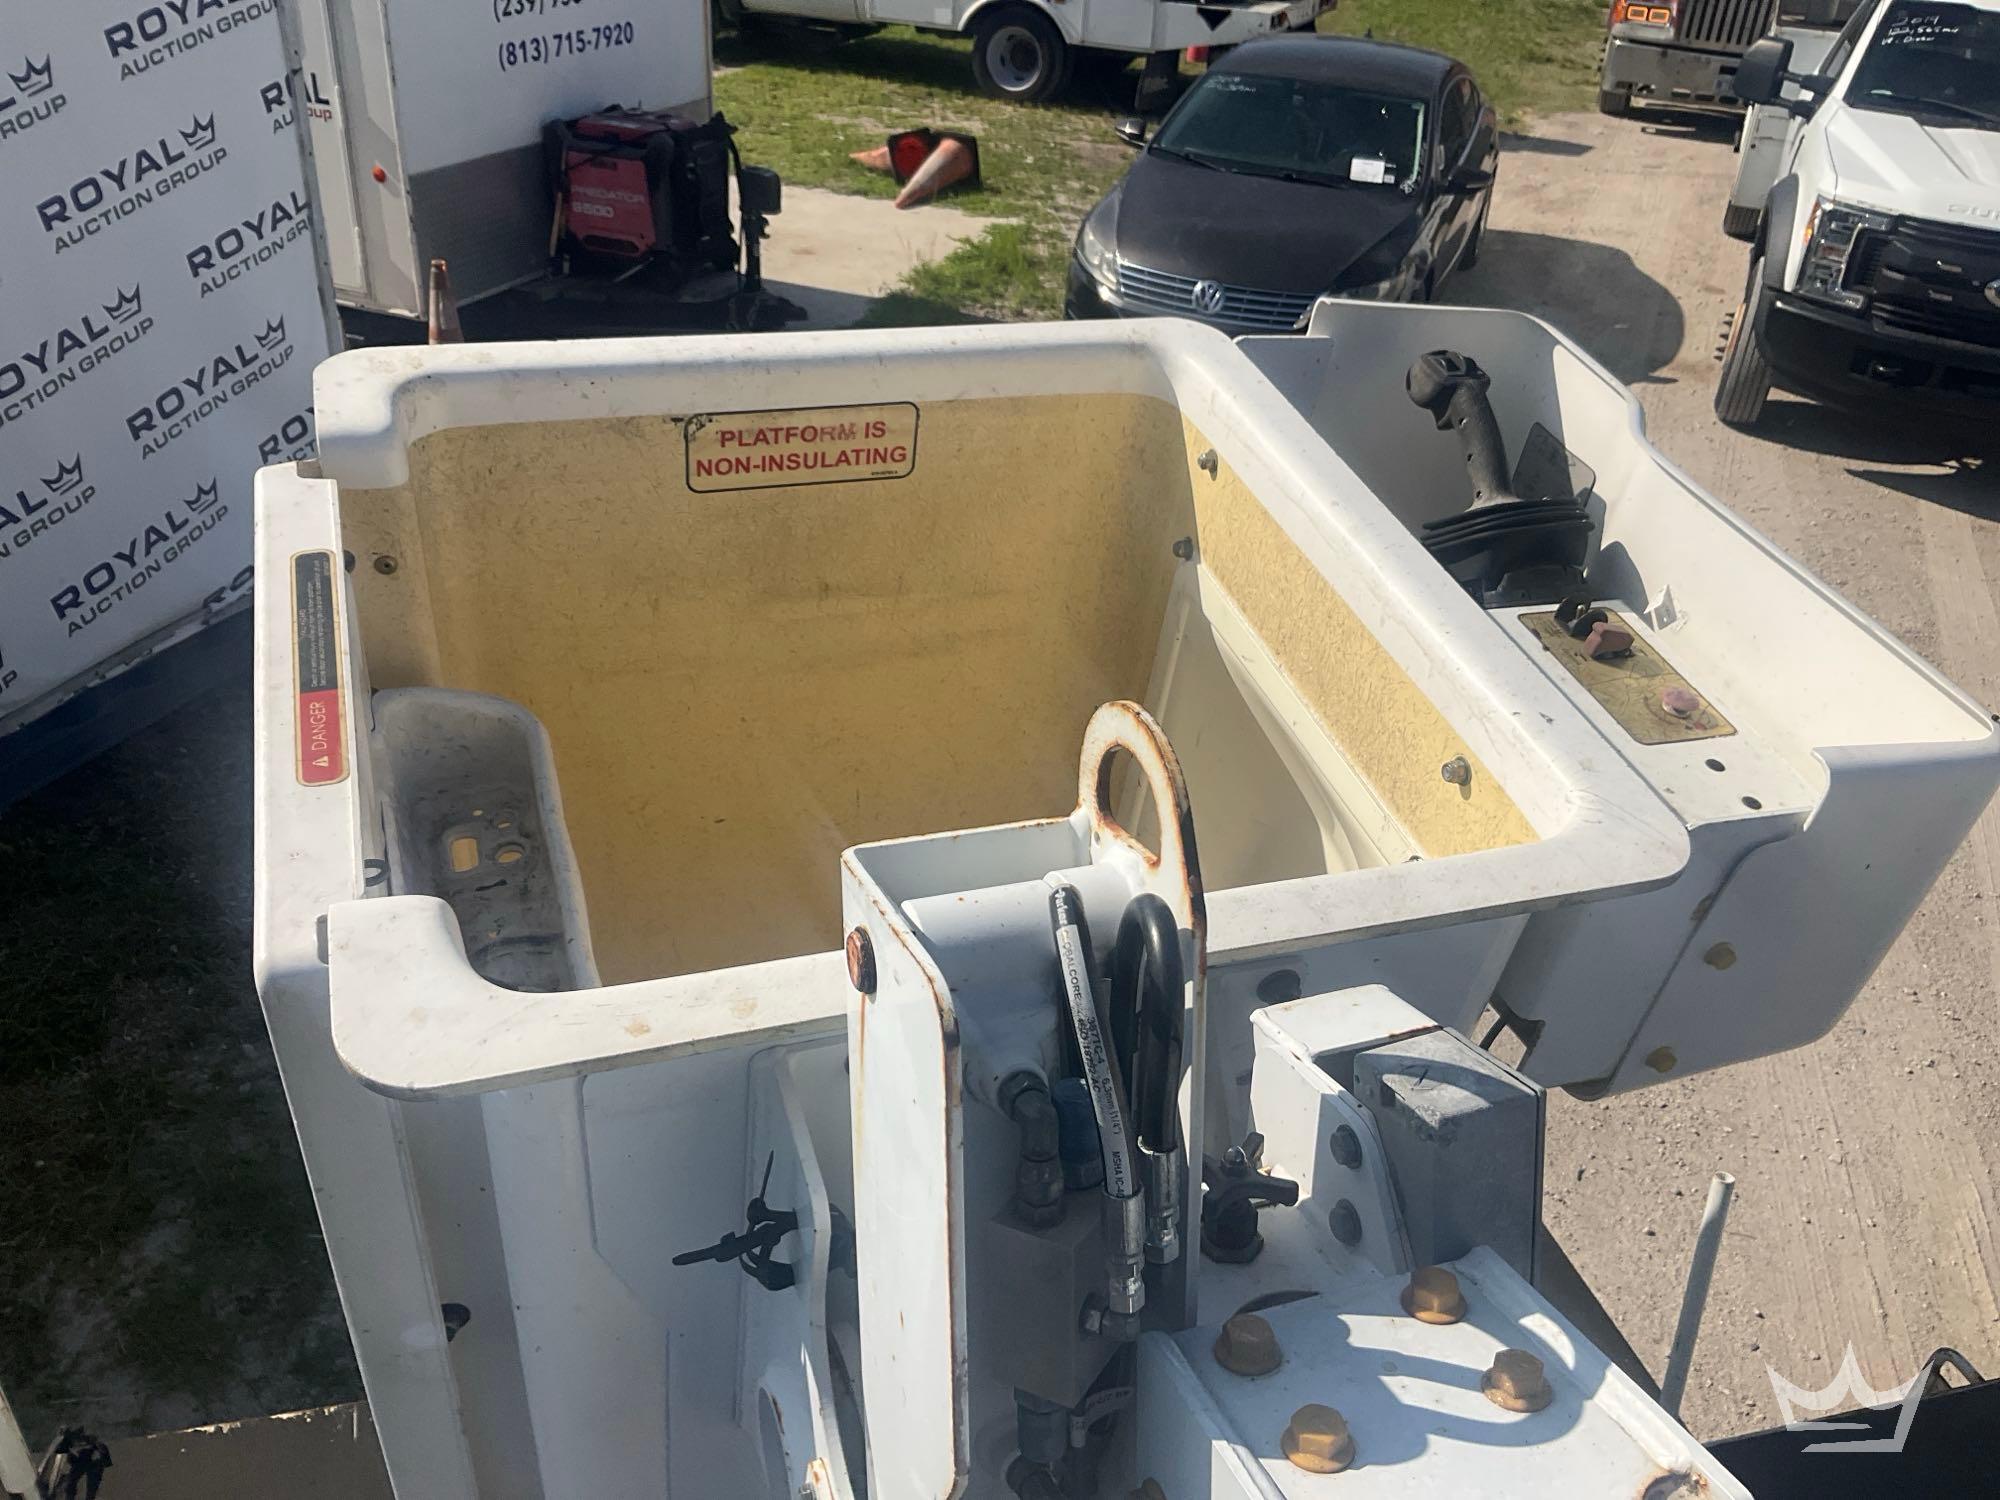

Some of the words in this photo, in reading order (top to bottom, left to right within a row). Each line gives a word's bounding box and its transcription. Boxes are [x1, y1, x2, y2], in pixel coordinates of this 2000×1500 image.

[120, 23, 214, 81] AUCTION
[499, 36, 549, 72] (813)
[553, 21, 634, 57] 715-7920
[36, 138, 186, 232] ROYAL
[55, 188, 153, 254] AUCTION
[155, 147, 228, 197] GROUP
[186, 191, 313, 278] ROYAL
[200, 237, 285, 298] AUCTION
[0, 367, 76, 428] CTION
[78, 317, 154, 374] GROUP
[126, 344, 260, 441] ROYAL
[141, 390, 229, 460] AUCTION
[231, 344, 293, 396] GROUP
[696, 446, 907, 478] NON-INSULATING
[719, 422, 855, 448] PLATFORM
[864, 420, 887, 439] IS
[13, 485, 97, 549] GROUP
[50, 510, 190, 621] ROYAL
[67, 562, 162, 638] AUCTION
[164, 505, 229, 563] GROUP
[309, 700, 327, 751] DANGER
[1061, 929, 1083, 1001] GLOBALCORE
[1111, 1151, 1123, 1176] MSHA
